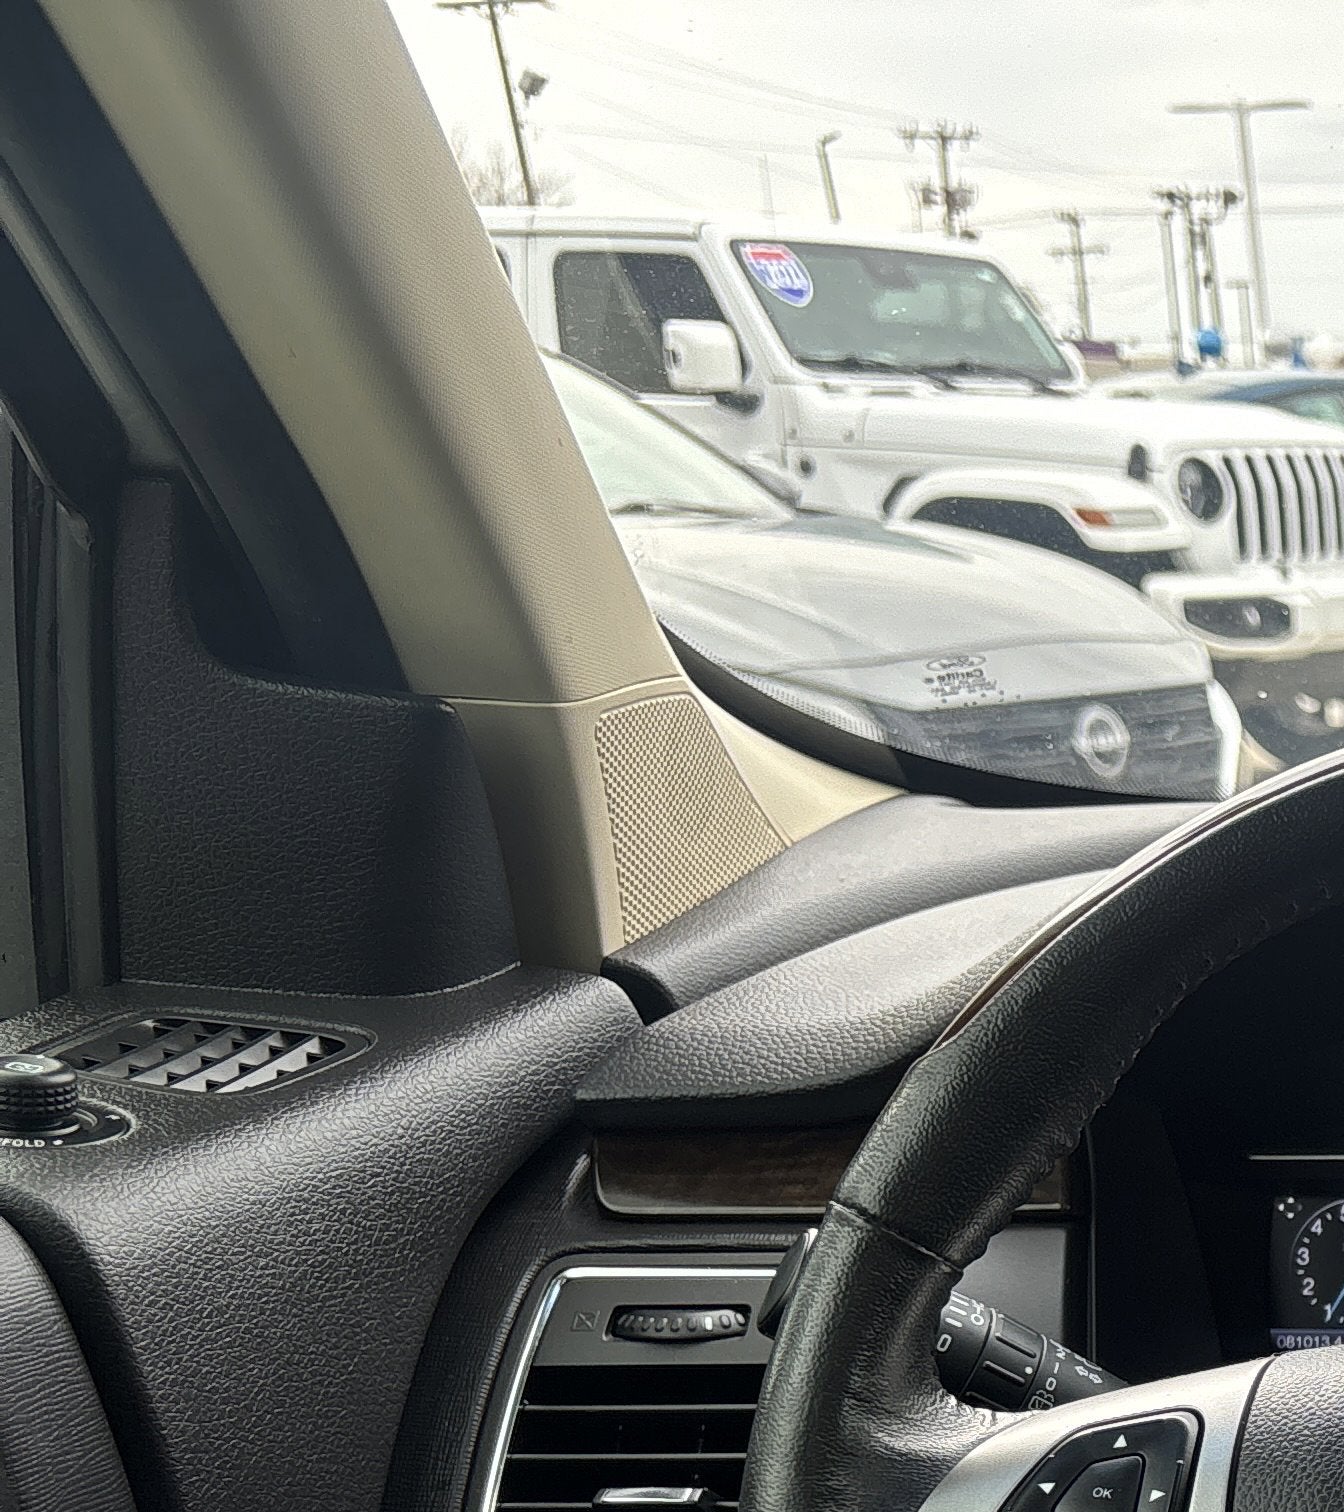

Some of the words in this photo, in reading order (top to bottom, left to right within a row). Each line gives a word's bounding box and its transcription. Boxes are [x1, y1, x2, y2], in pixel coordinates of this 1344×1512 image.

[1310, 1219, 1323, 1236] 4
[1297, 1247, 1309, 1265] 3
[1303, 1278, 1314, 1295] 2
[1093, 1487, 1113, 1498] OK
